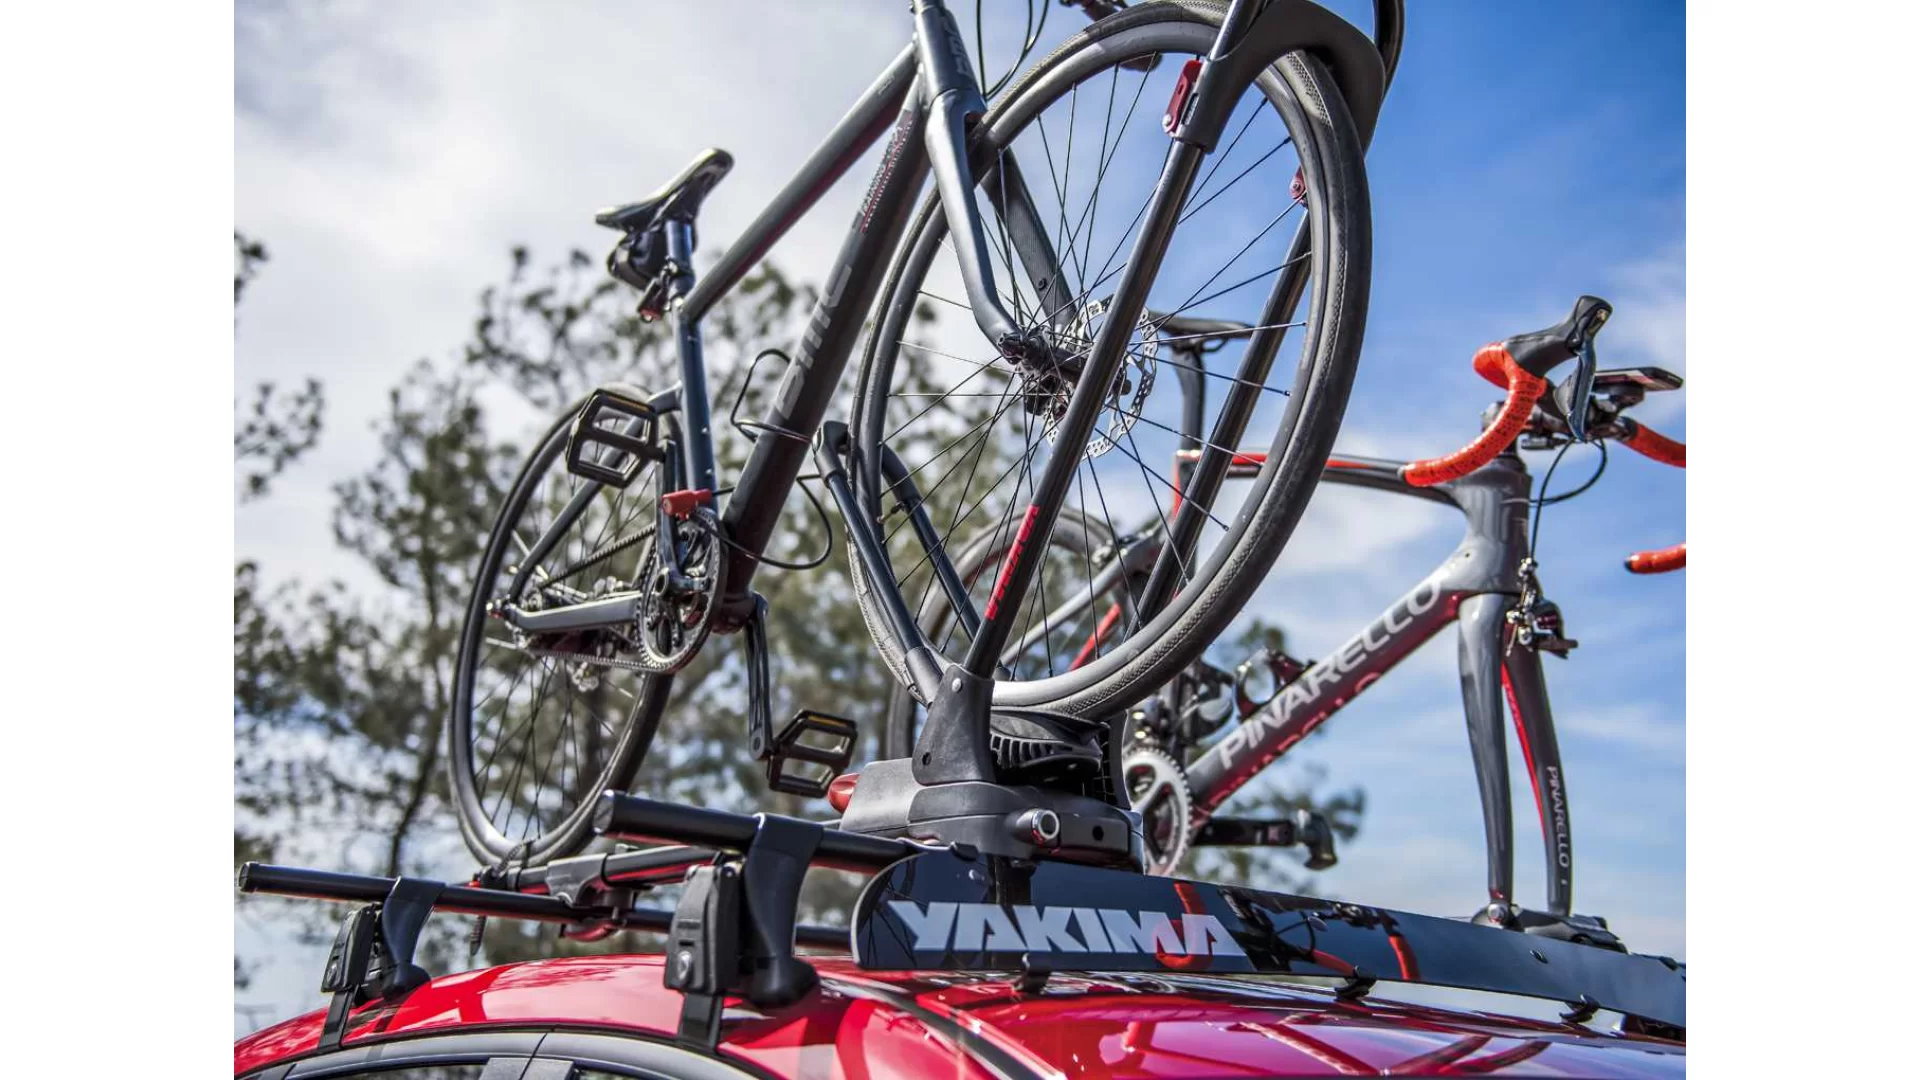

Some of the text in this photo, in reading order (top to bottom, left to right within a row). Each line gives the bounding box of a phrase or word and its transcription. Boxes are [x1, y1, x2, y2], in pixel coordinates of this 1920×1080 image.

[1218, 577, 1442, 770] PINARELLO
[1546, 765, 1570, 868] PINARELLO
[887, 899, 1248, 957] YAKIMA
